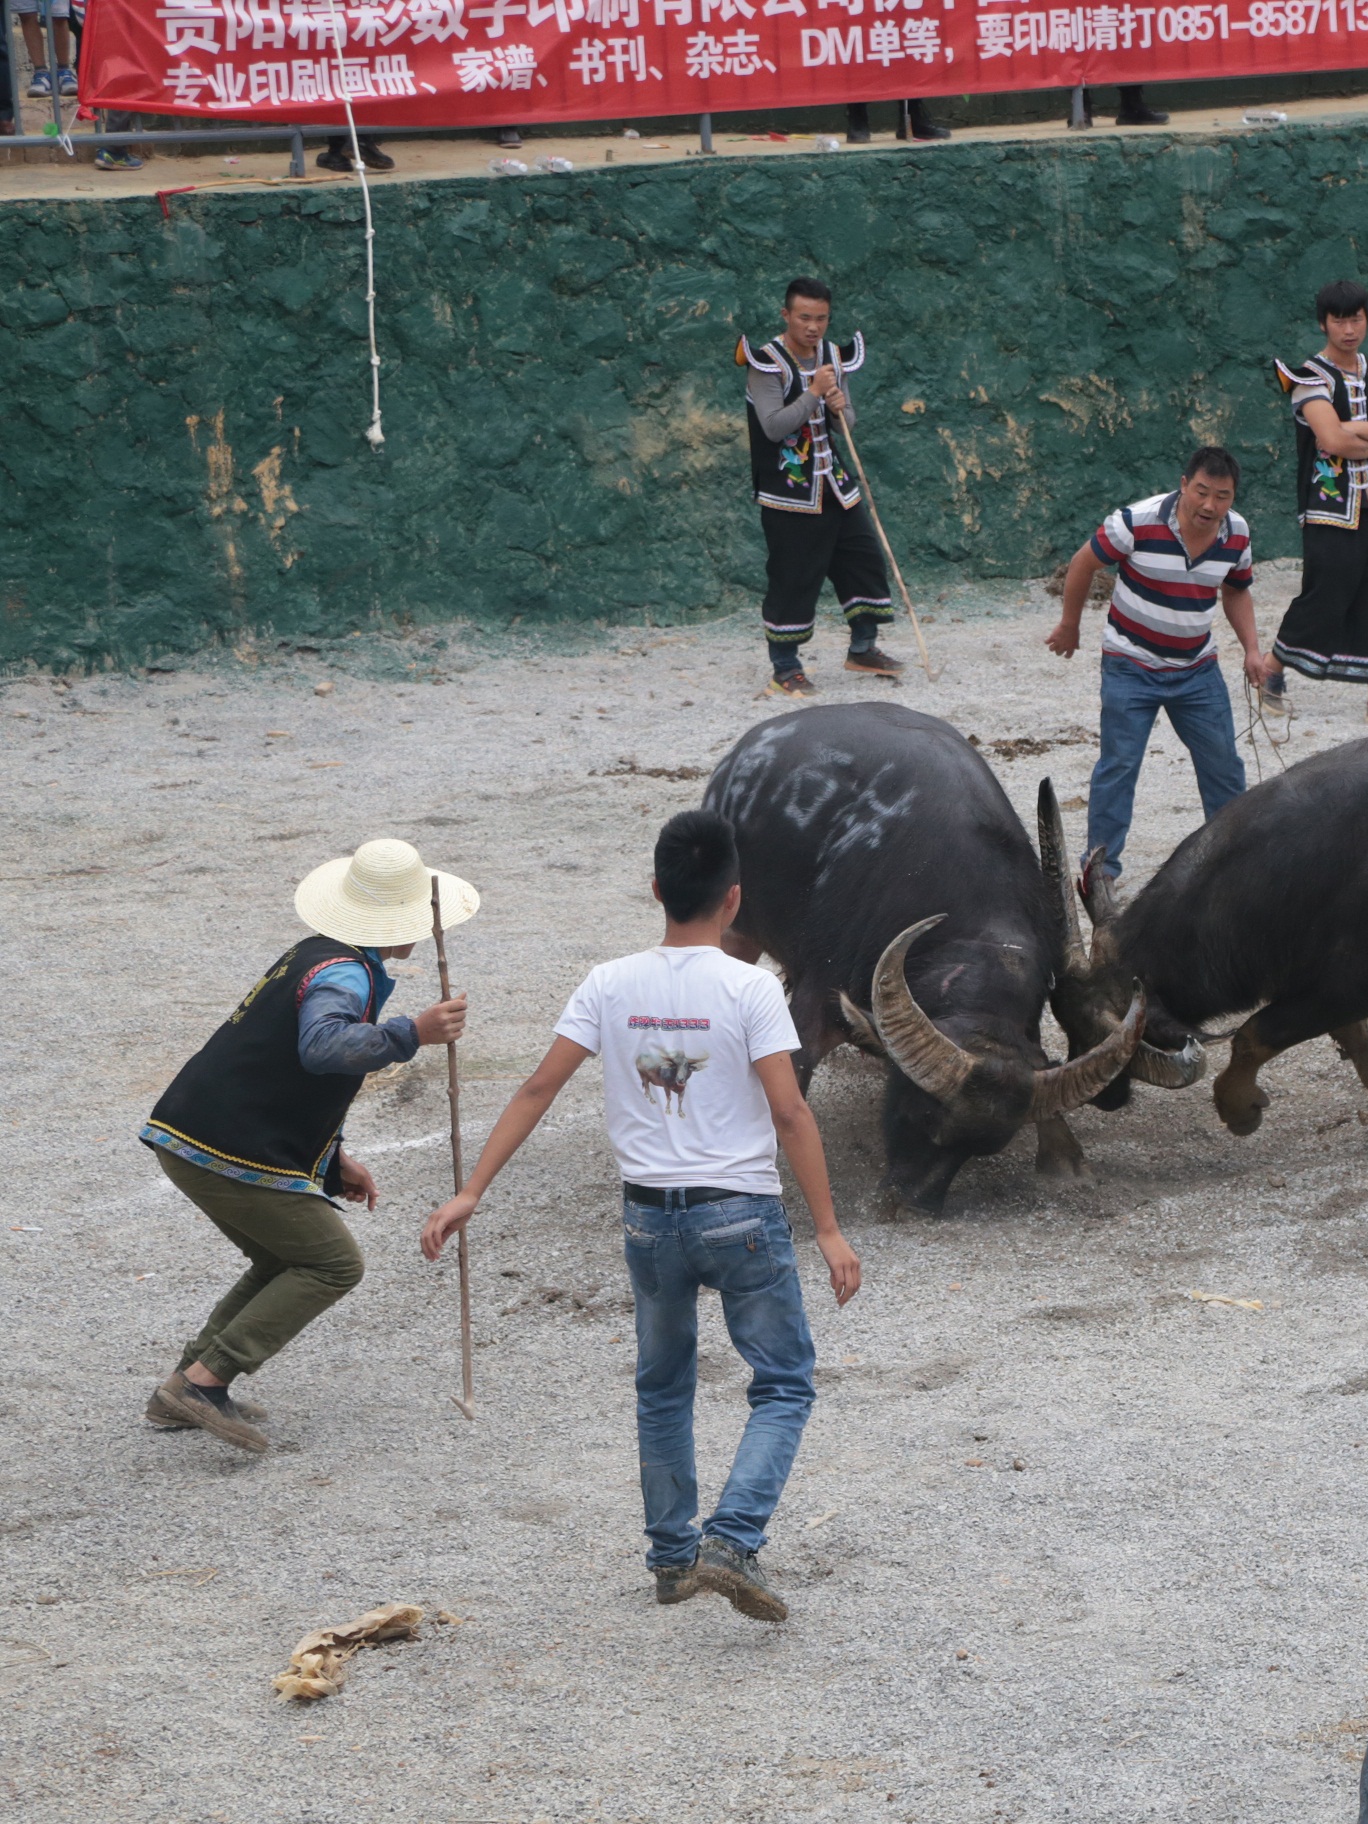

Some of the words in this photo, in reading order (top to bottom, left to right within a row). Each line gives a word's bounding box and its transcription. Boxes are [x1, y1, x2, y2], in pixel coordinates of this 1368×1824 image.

[155, 0, 1032, 56] 贵阳精彩数字印刷
